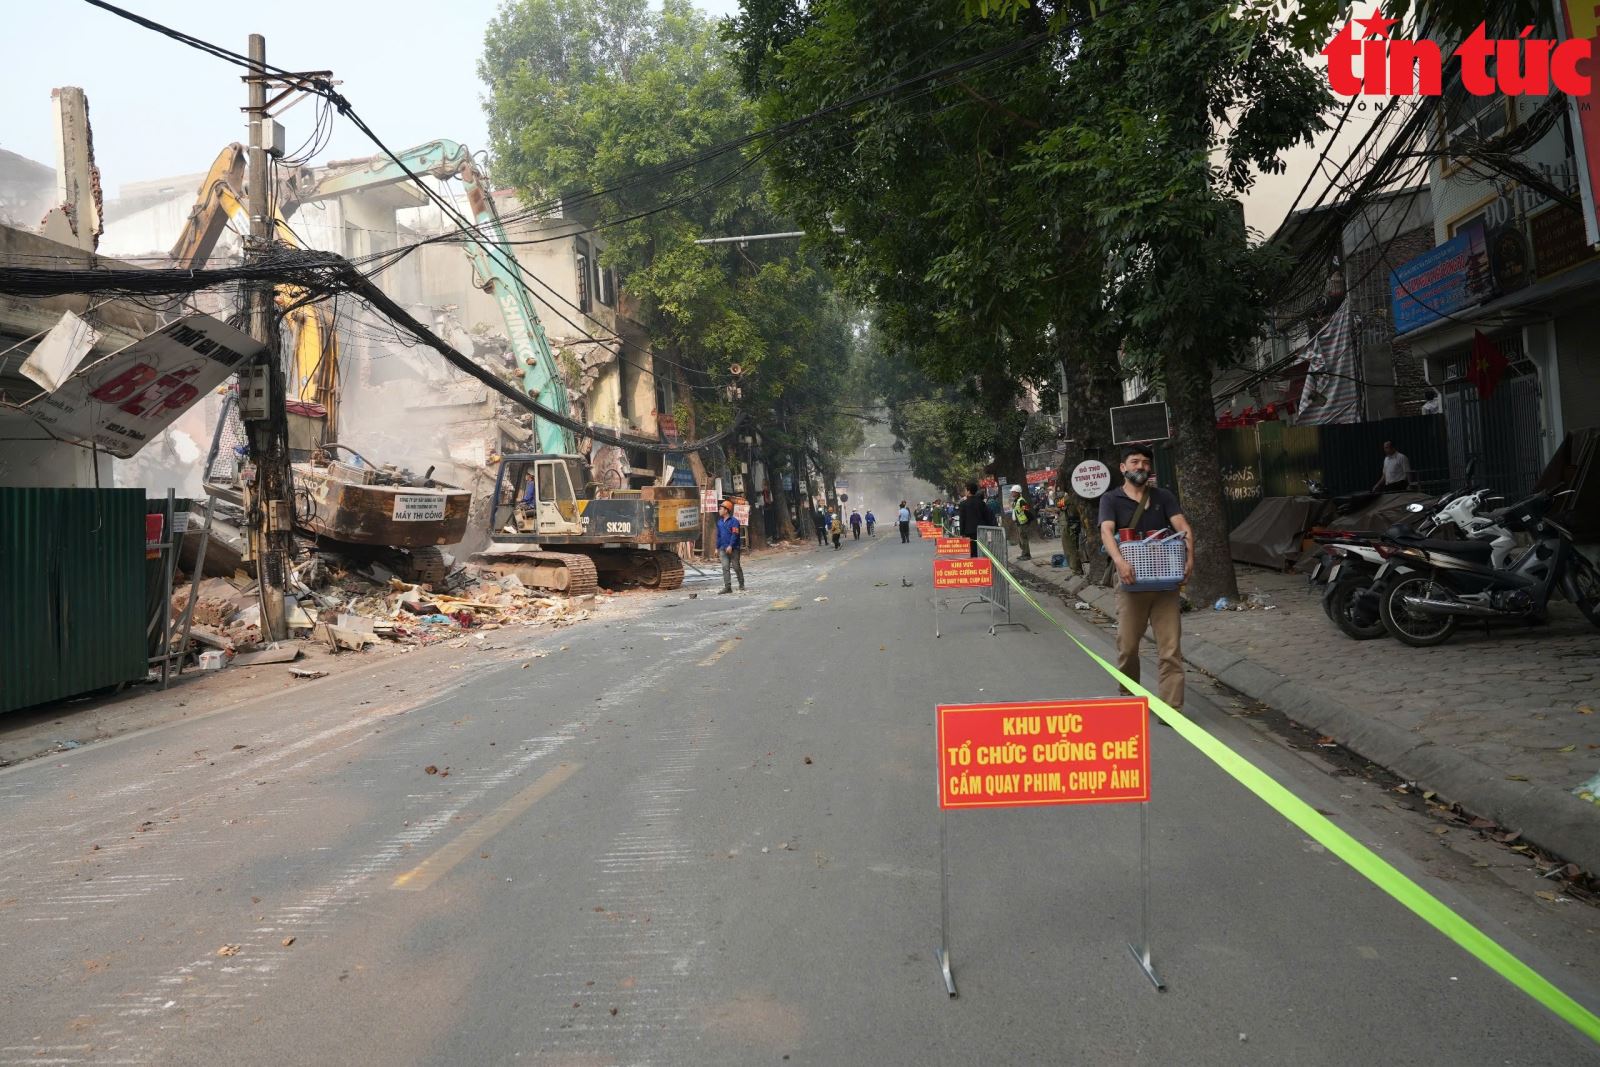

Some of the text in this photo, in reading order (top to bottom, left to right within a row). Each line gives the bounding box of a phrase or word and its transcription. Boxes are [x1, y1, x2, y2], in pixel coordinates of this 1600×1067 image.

[606, 522, 631, 533] SK200
[1003, 713, 1083, 738] KHU VỰC
[948, 734, 1139, 766] TỔ CHỨC CƯỠNG CHẾ
[950, 765, 1140, 796] CẤM QUAY PHIM, CHỤP ẢNH
